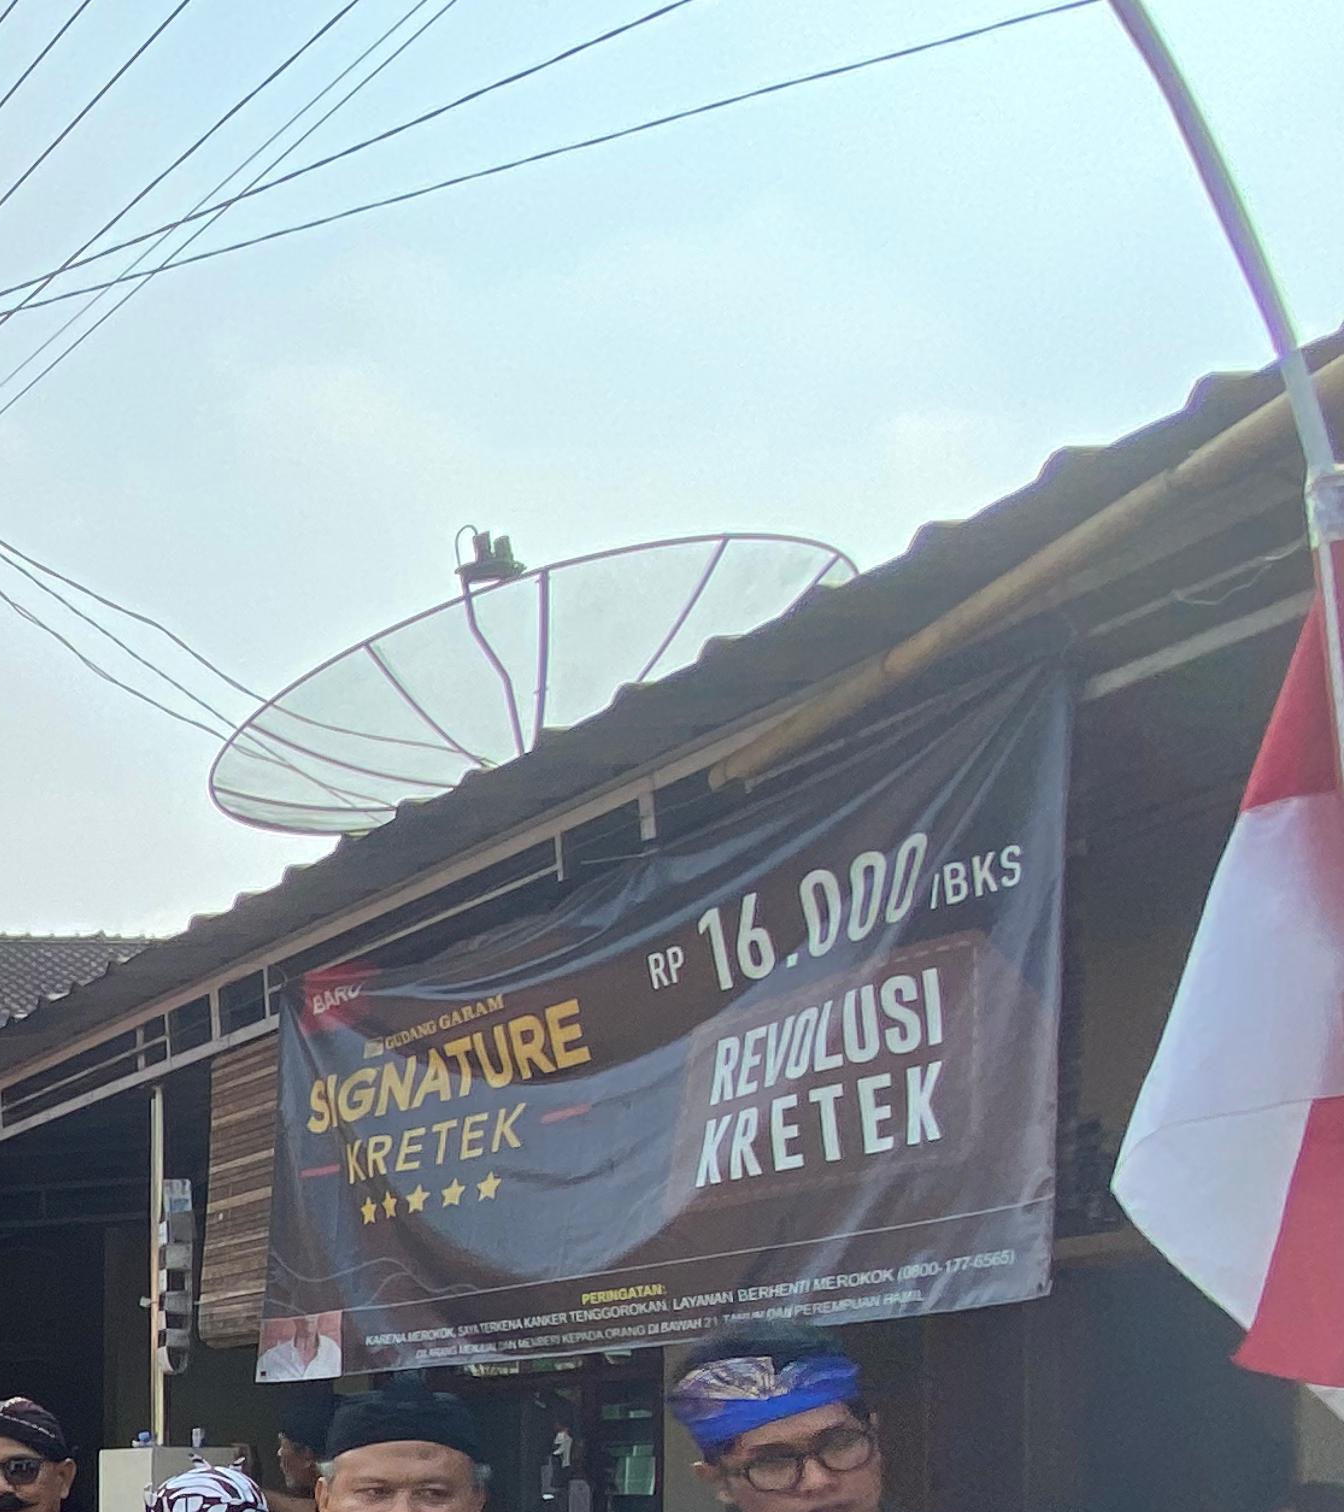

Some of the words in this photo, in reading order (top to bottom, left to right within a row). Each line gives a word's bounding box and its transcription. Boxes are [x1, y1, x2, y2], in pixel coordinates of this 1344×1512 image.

[647, 945, 685, 990] RP
[698, 832, 928, 991] 16.000
[930, 844, 1022, 910] /BKS
[307, 999, 591, 1134] SIGNATURE
[384, 1020, 438, 1050] GUDANG
[438, 993, 505, 1030] GARAM
[709, 967, 943, 1106] REVOLUSI
[346, 1102, 528, 1184] KRETEK
[695, 1060, 943, 1188] KRETEK
[523, 1312, 568, 1328] KANKER
[673, 1291, 733, 1310] LAYANAN
[738, 1279, 810, 1302] BERHENTI
[812, 1268, 893, 1292] MEROKOK
[604, 1324, 646, 1339] ORANG
